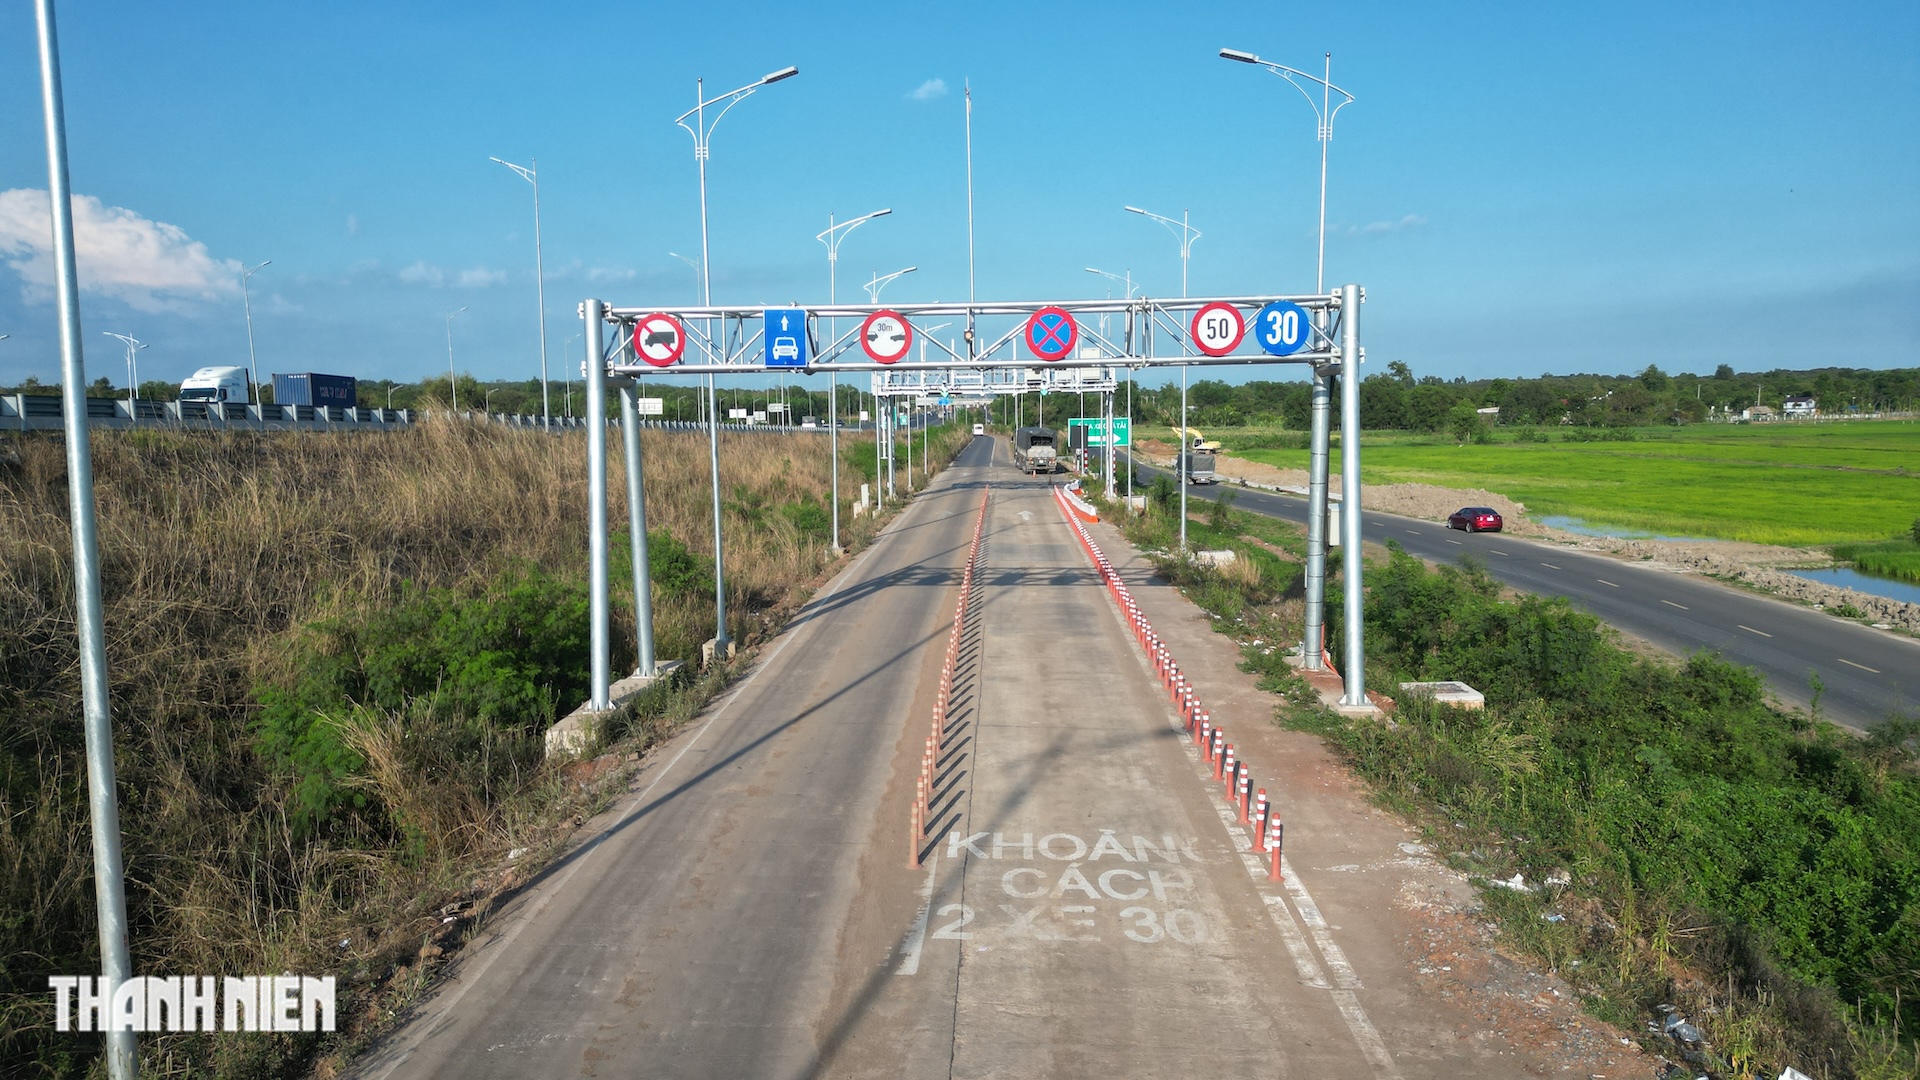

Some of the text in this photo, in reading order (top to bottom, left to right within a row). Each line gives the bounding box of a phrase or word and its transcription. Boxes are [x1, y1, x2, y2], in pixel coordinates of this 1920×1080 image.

[877, 322, 893, 332] 30m
[1207, 318, 1229, 340] 50
[1266, 310, 1299, 345] 30
[931, 903, 976, 940] 2
[1119, 906, 1208, 945] 30
